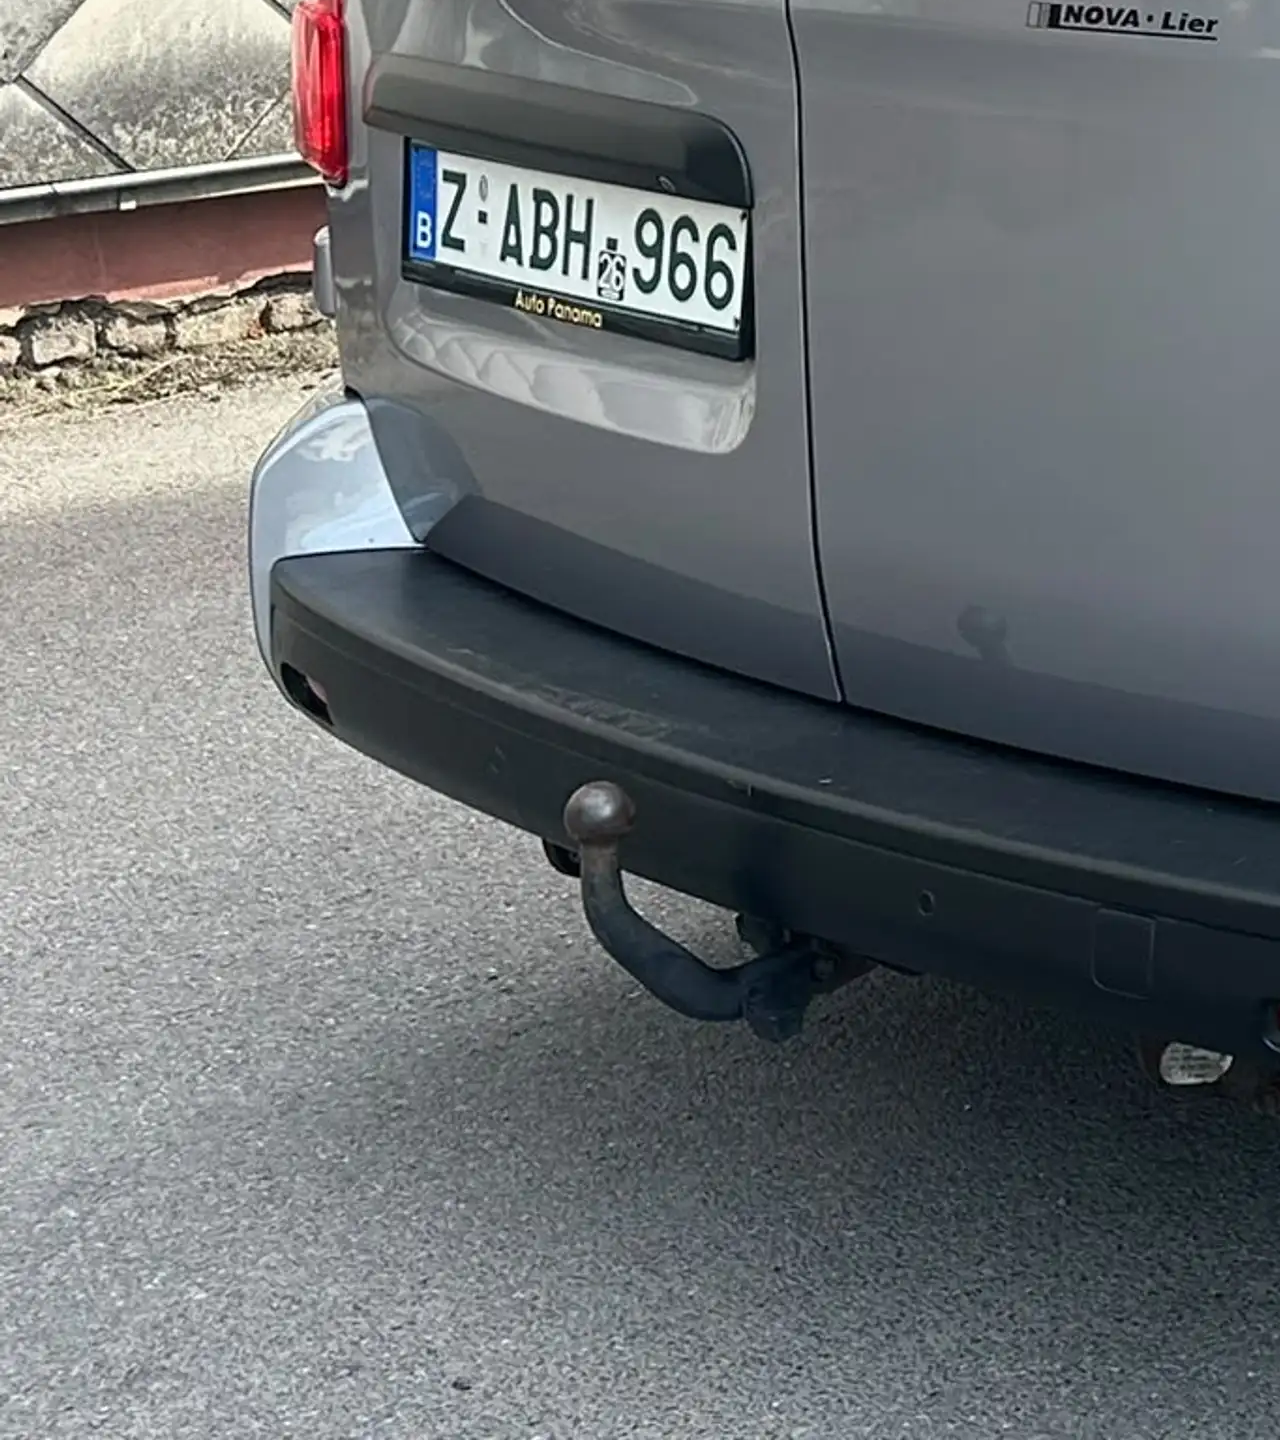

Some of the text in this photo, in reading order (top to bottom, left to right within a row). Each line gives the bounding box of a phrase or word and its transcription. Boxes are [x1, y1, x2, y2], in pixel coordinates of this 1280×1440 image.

[1063, 3, 1219, 35] NOVA Lier
[415, 210, 433, 249] B
[514, 286, 604, 329] Auto Panama
